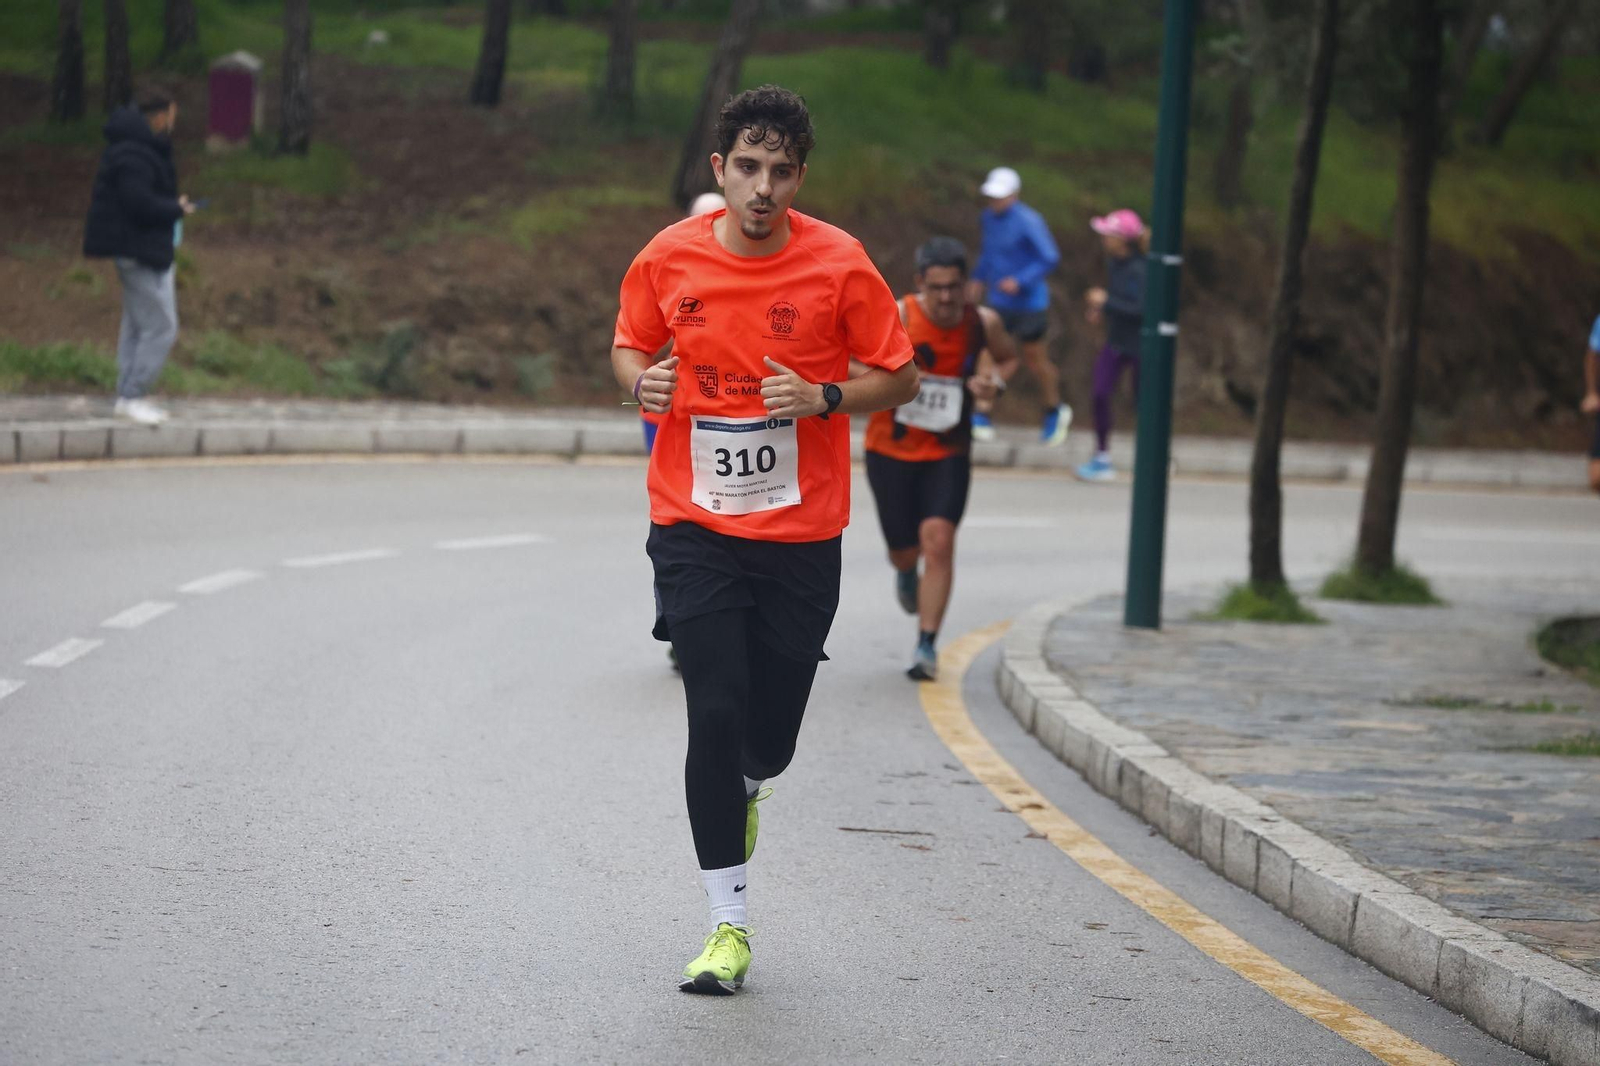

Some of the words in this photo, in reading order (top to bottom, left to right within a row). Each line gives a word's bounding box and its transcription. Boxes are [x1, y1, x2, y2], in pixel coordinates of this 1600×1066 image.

[725, 373, 763, 384] Ciudad
[725, 386, 738, 395] de
[741, 386, 761, 395] Mál
[715, 445, 777, 477] 310
